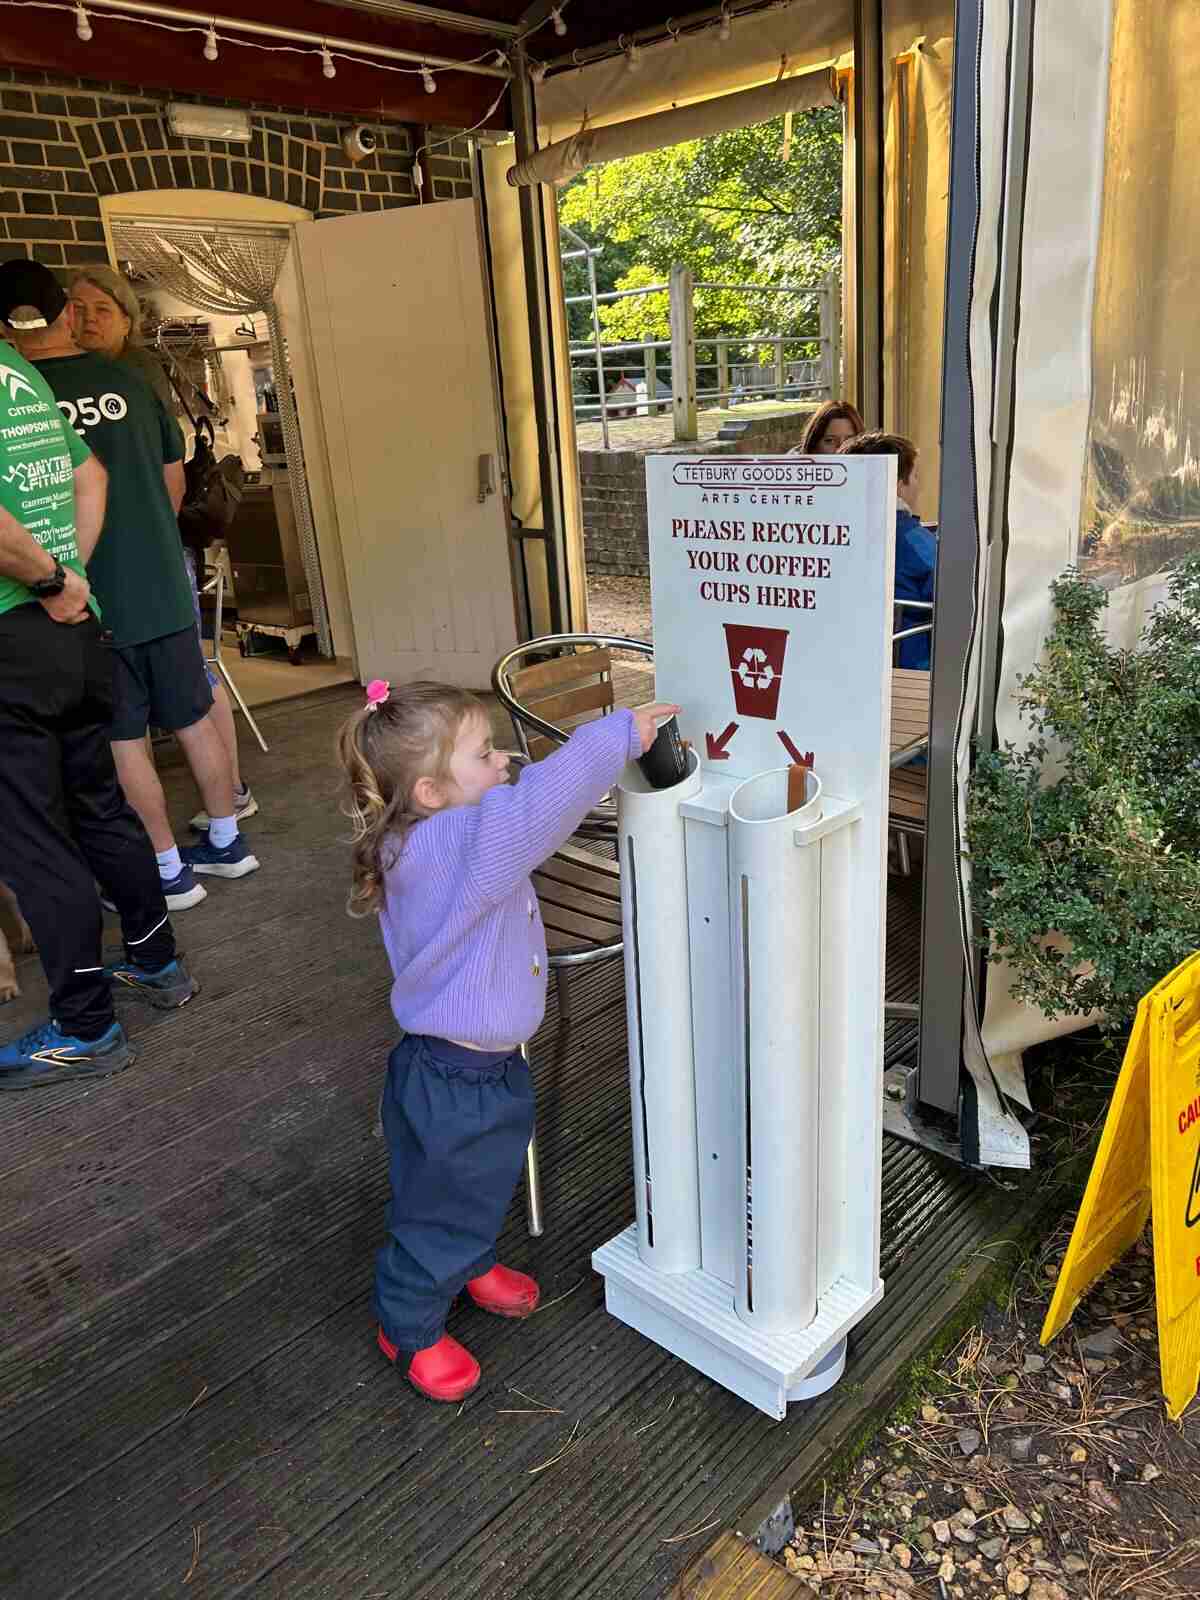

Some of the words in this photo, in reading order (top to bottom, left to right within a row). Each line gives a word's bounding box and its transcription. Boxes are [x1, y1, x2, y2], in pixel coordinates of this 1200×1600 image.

[0, 421, 49, 439] THOMPSON
[684, 466, 737, 481] TETBURY
[742, 467, 792, 481] GOODS
[797, 468, 833, 482] SHED
[702, 493, 740, 503] ARTS
[750, 494, 814, 505] CENTRE
[672, 518, 745, 541] PLEASE
[752, 522, 850, 546] RECYCLE
[686, 550, 740, 573] YOUR
[746, 553, 831, 578] COFFEE
[700, 581, 750, 604] CUPS
[757, 586, 816, 610] HERE
